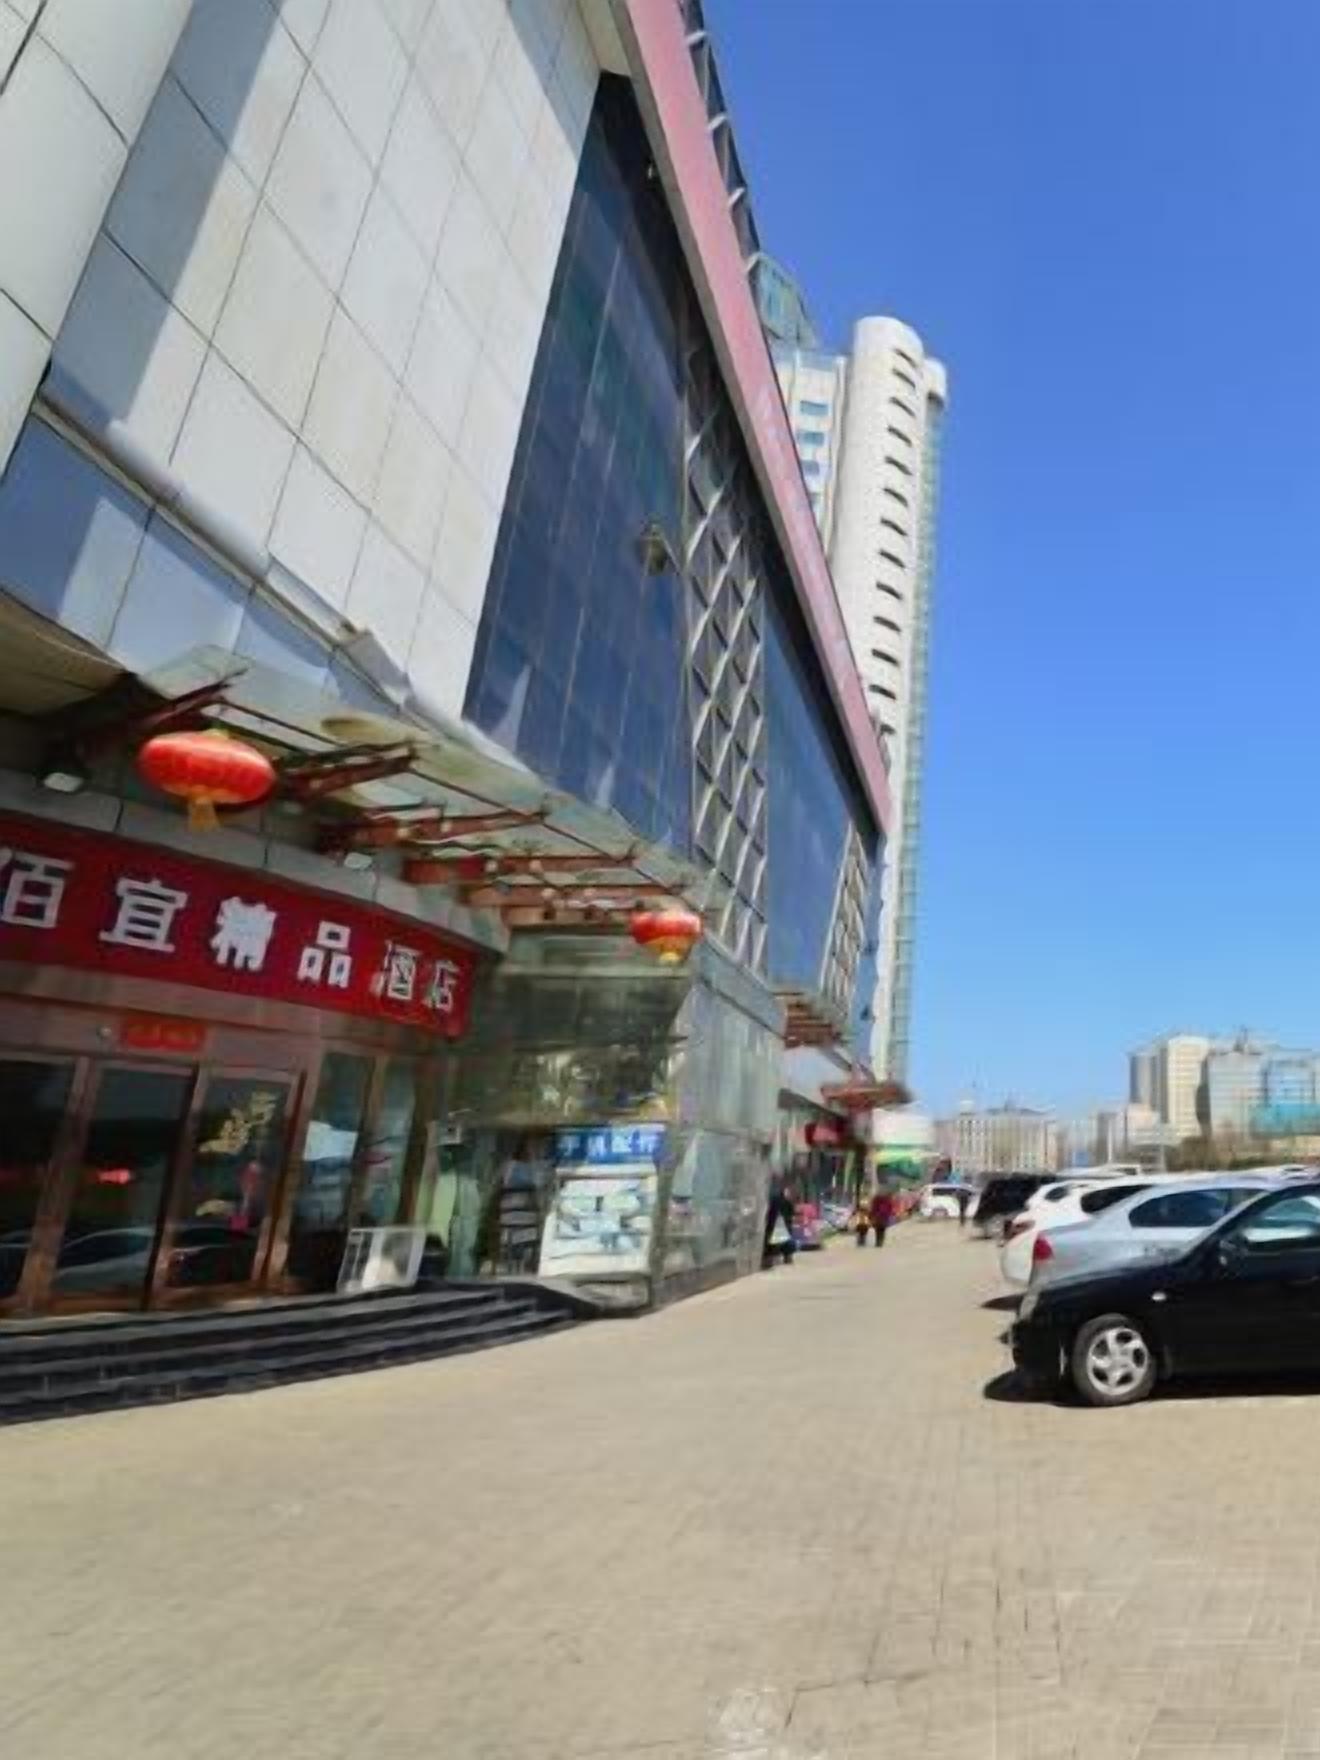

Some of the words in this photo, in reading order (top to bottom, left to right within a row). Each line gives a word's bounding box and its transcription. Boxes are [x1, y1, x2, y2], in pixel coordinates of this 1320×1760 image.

[0, 847, 459, 1012] 佰宜精品酒店
